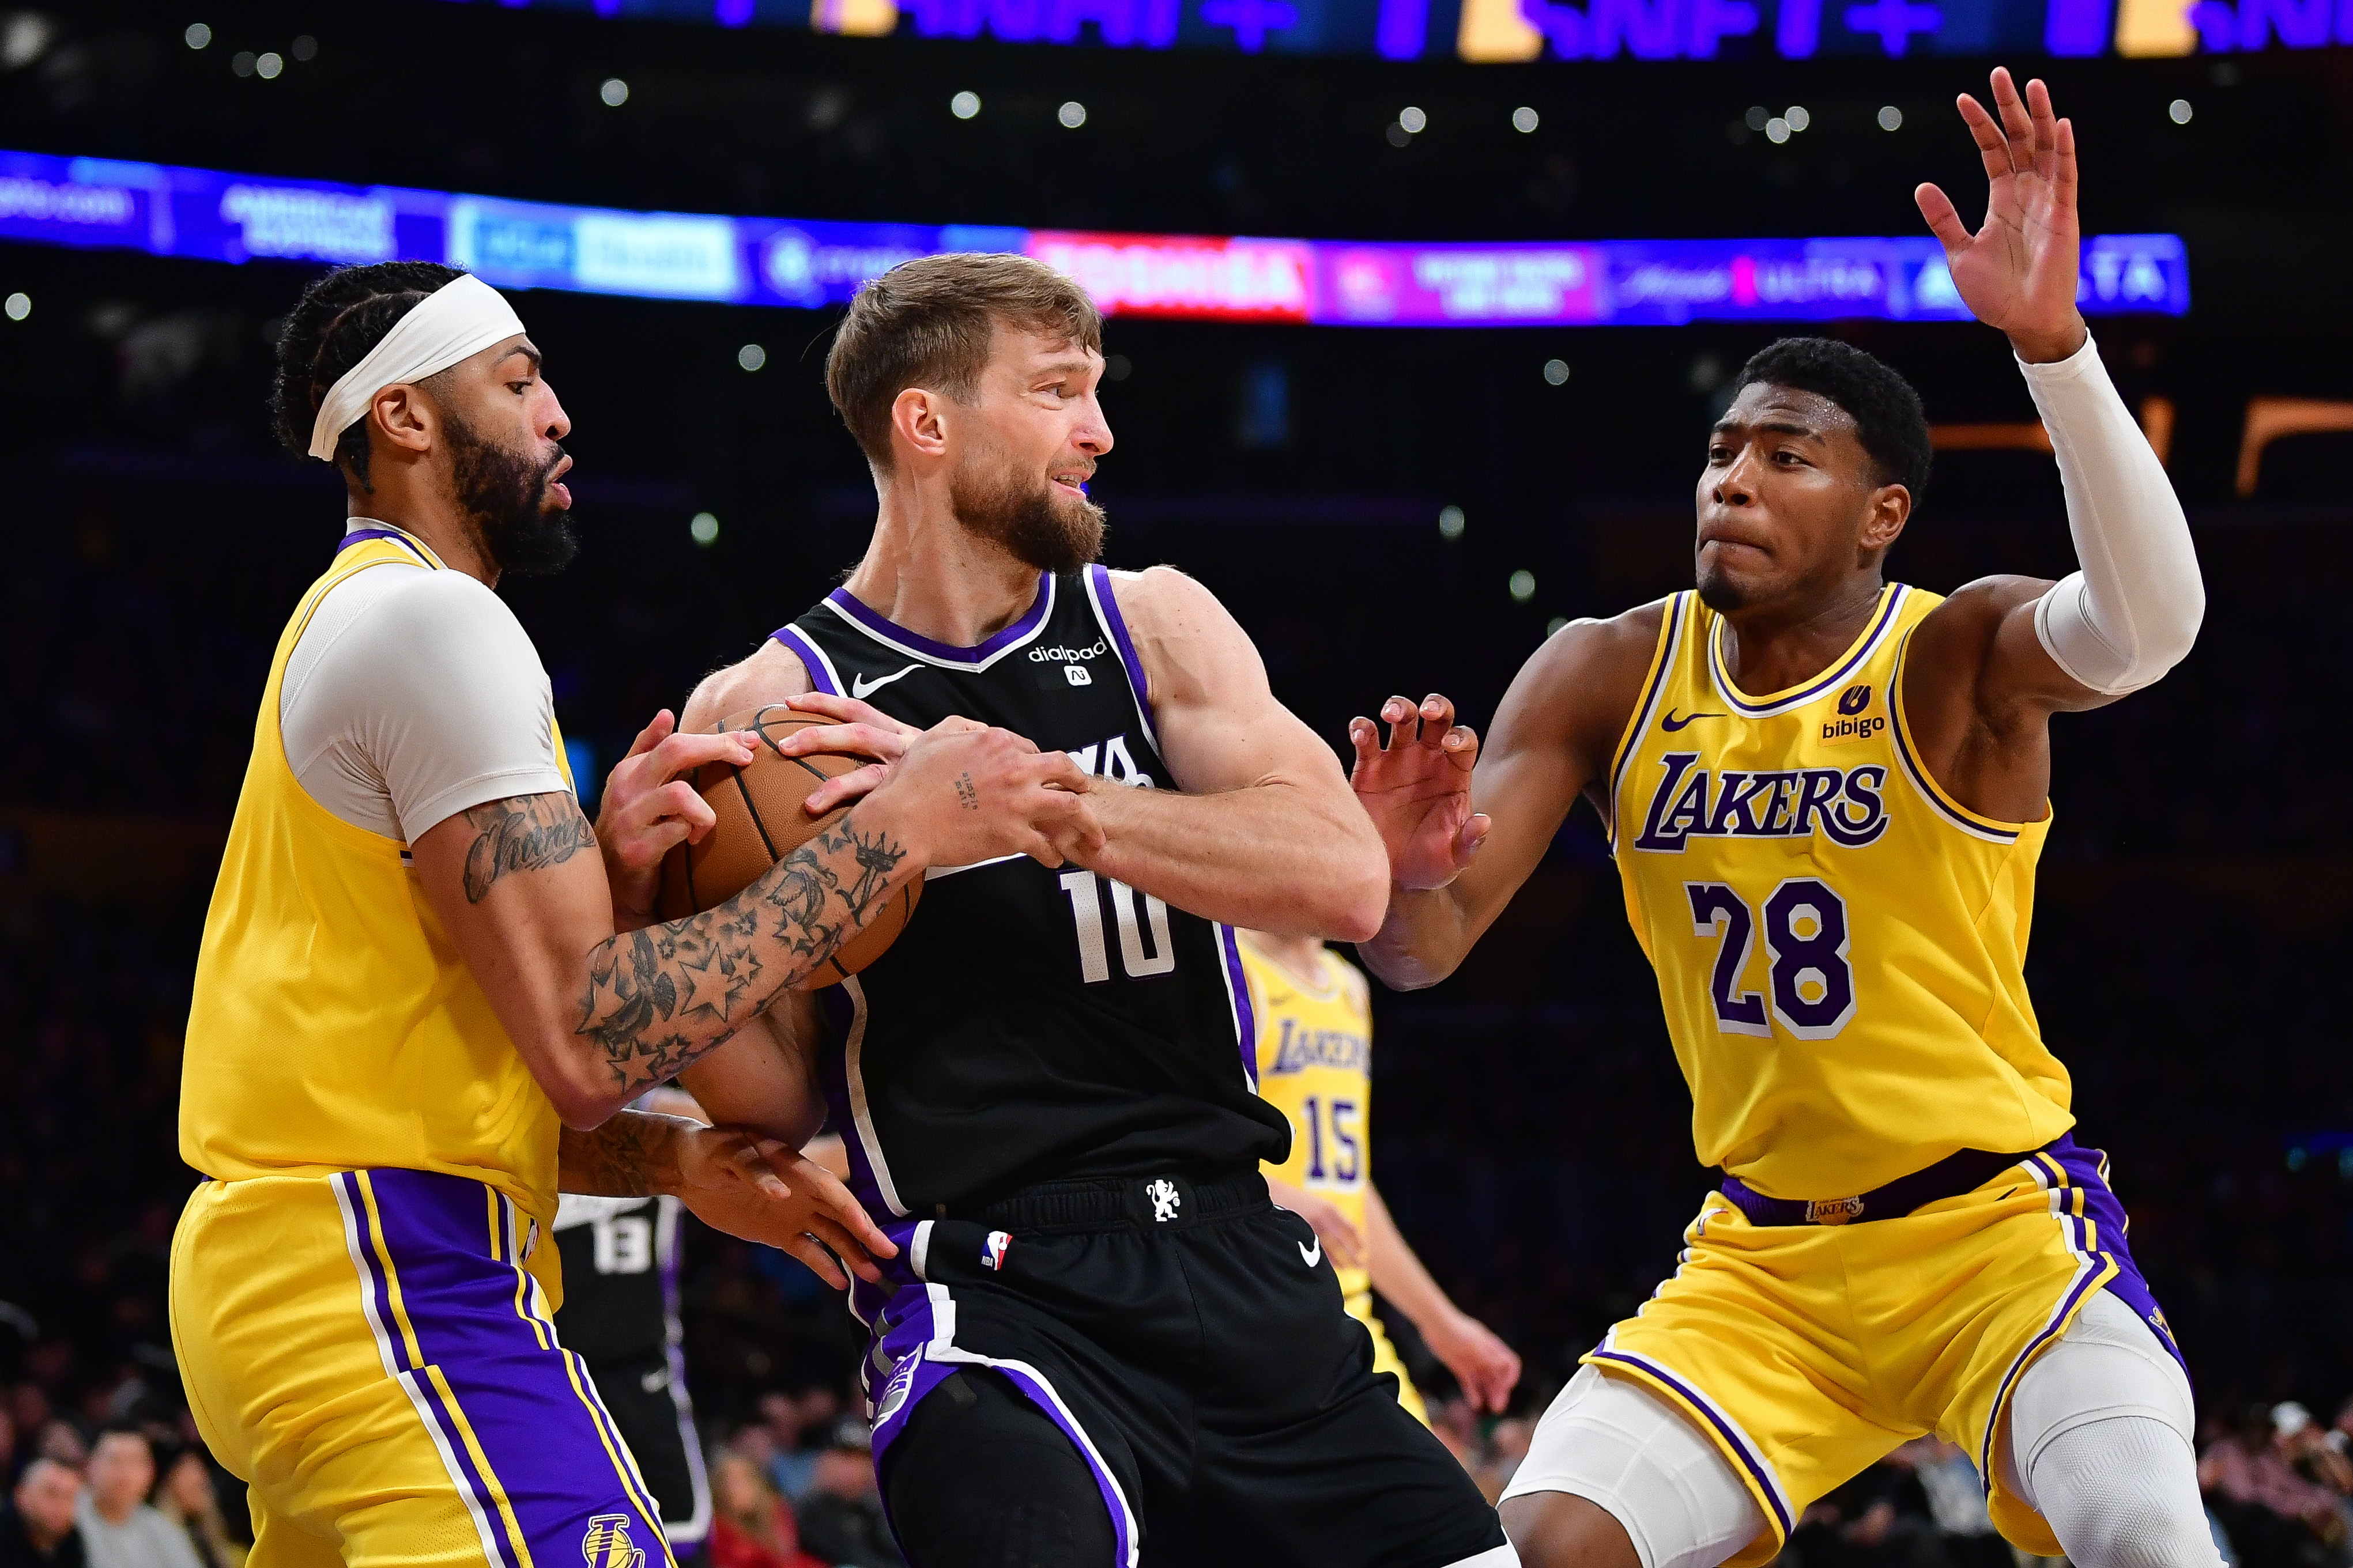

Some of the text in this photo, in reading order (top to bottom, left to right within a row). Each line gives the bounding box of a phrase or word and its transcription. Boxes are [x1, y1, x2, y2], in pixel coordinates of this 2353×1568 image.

[1028, 636, 1107, 664] dialpad
[1822, 717, 1885, 739] bibigo
[1634, 751, 1892, 853] LAKERS
[1059, 869, 1175, 984] 10
[1683, 877, 1857, 1041] 28
[1303, 1096, 1362, 1191] 15
[594, 1217, 652, 1275] 13
[981, 1255, 993, 1267] NBA
